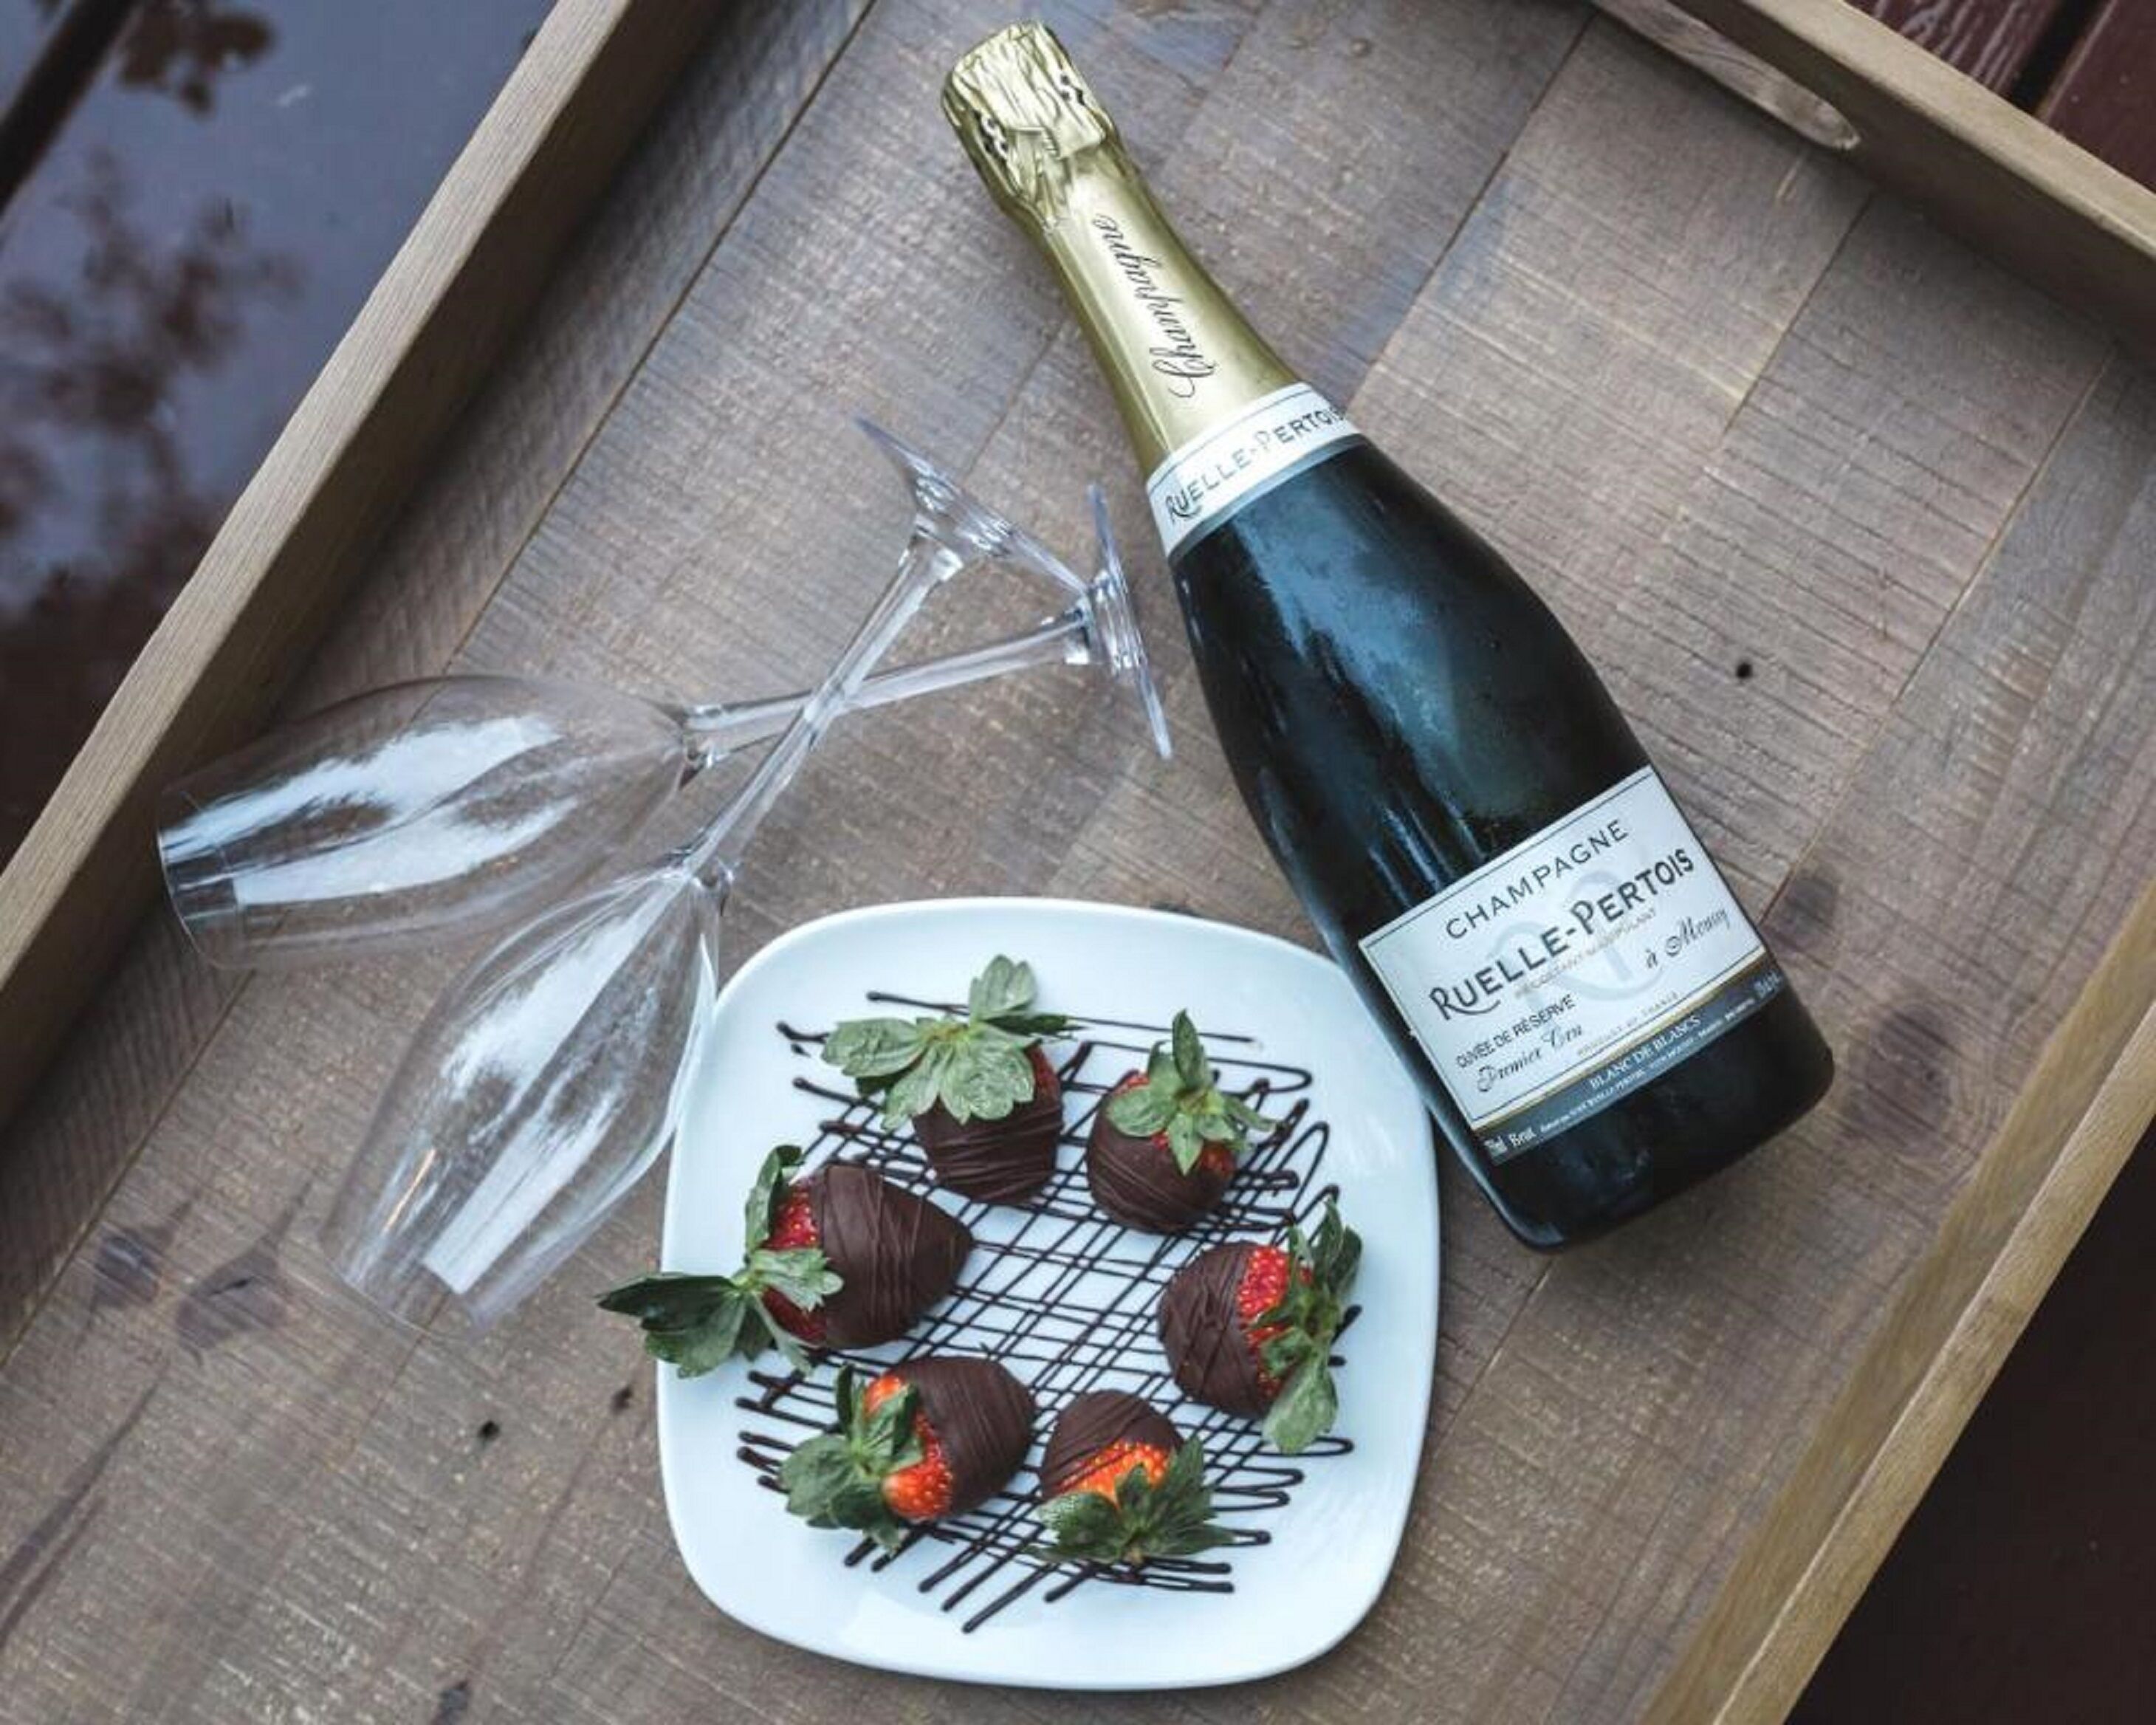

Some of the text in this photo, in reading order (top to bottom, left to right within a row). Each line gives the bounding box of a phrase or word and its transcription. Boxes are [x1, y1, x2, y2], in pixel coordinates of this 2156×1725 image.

[1093, 213, 1215, 399] Champagne
[1429, 848, 1695, 1021] RUELLE-PERTOIS
[1445, 818, 1629, 939] CHAMPAGNE
[1493, 1030, 1512, 1049] DE
[1590, 1058, 1633, 1089] BLANC
[1633, 1042, 1655, 1061] DE
[1652, 1015, 1701, 1052] BLANCS
